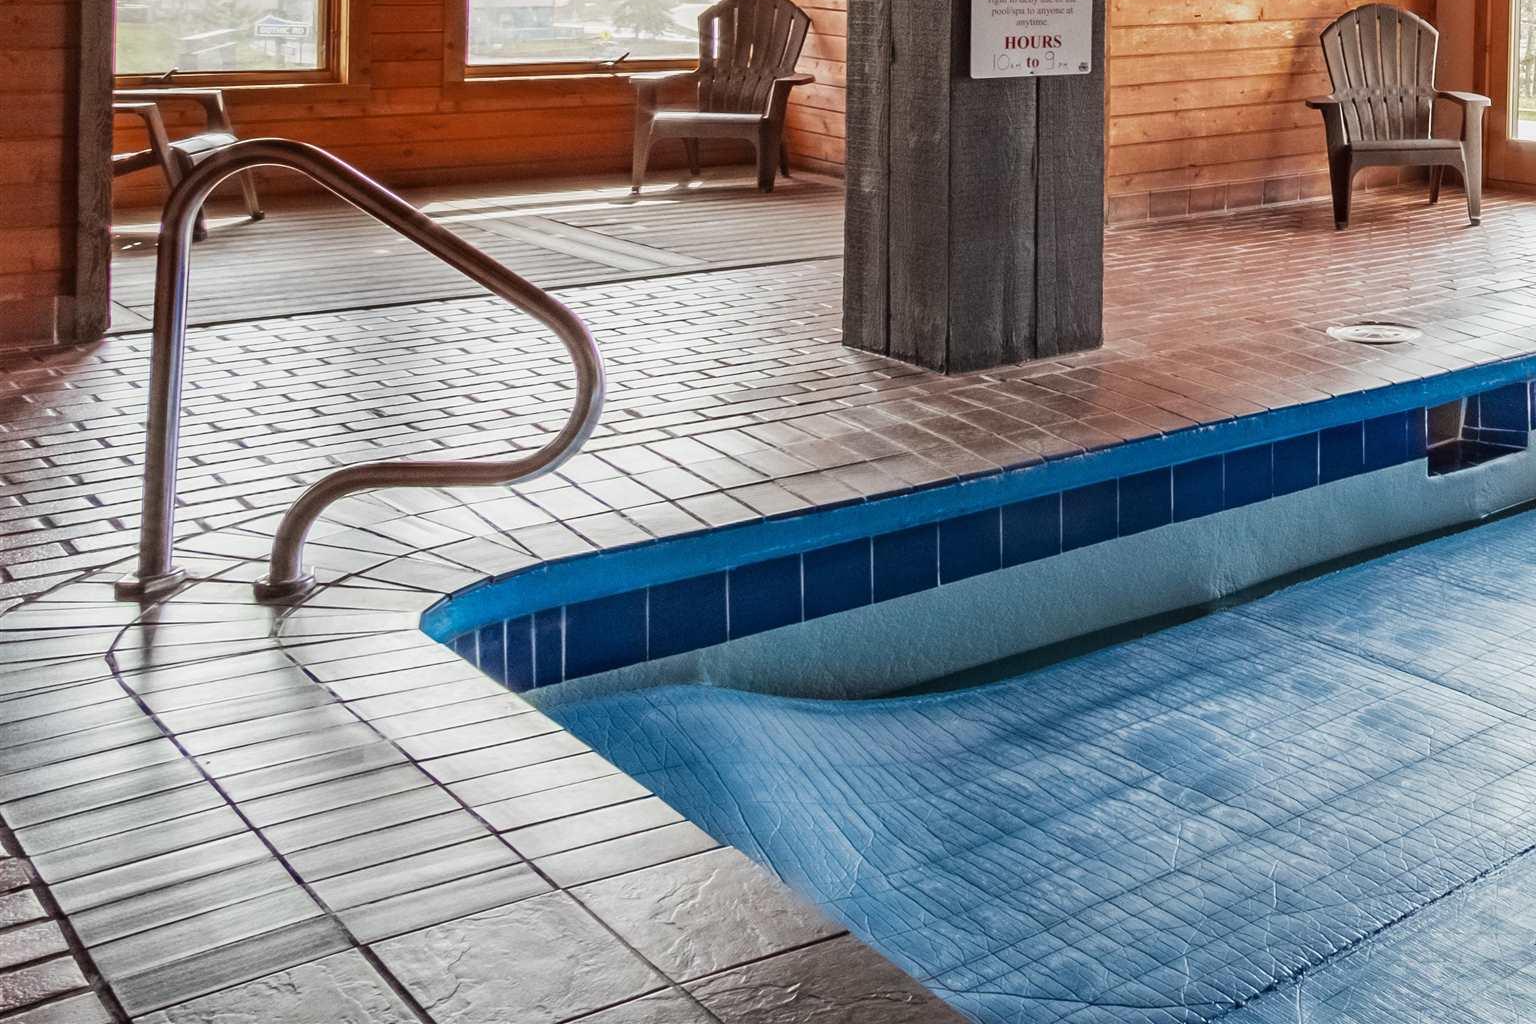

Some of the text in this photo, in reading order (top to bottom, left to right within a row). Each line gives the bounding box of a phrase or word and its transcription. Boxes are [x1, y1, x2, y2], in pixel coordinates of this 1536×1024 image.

[991, 6, 1025, 16] pool/spa
[1027, 7, 1035, 15] to
[1036, 8, 1064, 17] anyone
[1004, 35, 1062, 49] HOURS
[1026, 56, 1040, 68] to
